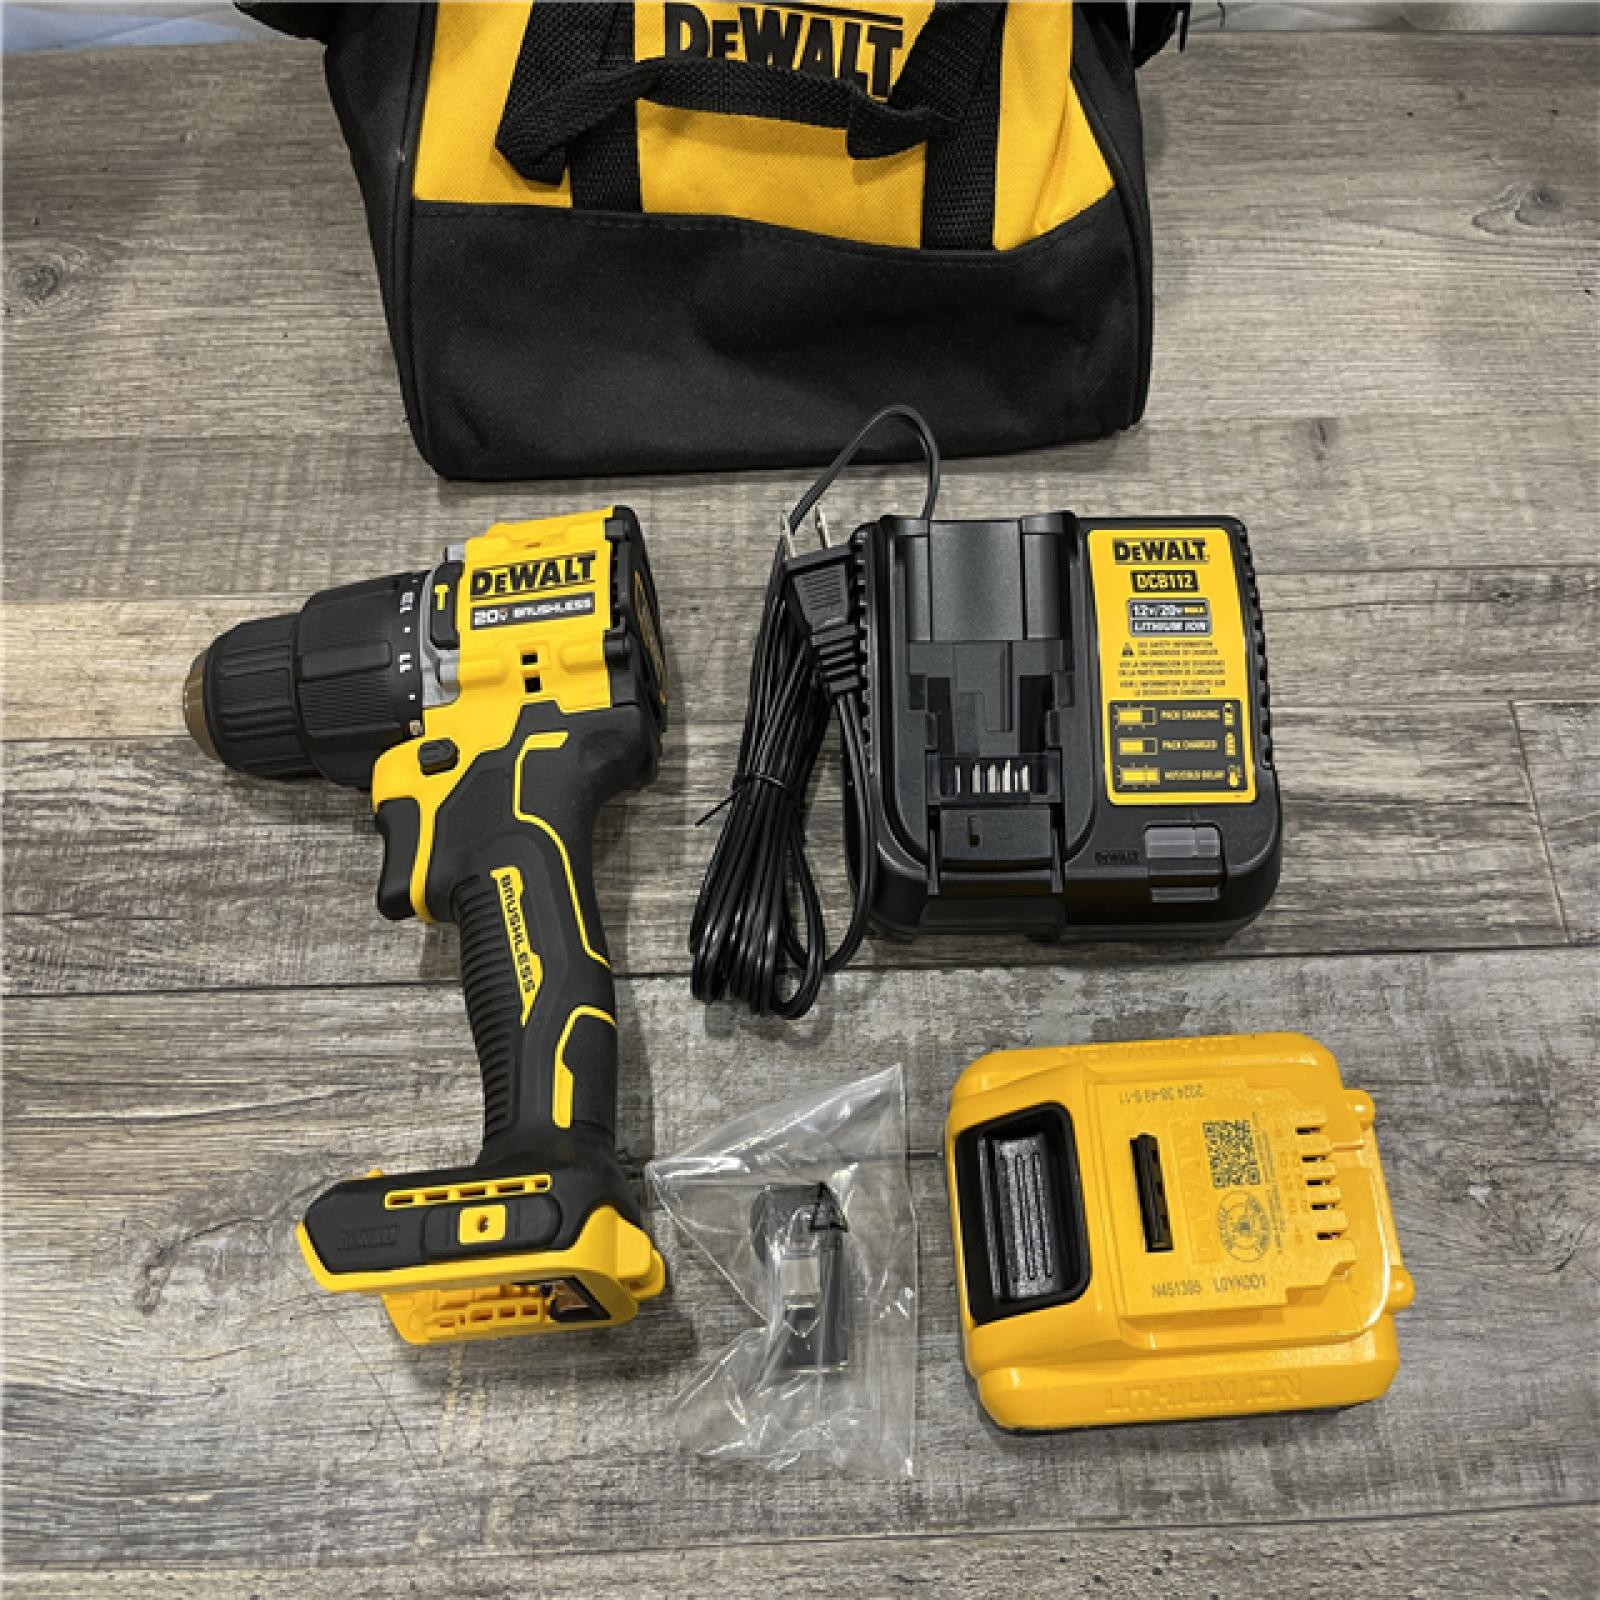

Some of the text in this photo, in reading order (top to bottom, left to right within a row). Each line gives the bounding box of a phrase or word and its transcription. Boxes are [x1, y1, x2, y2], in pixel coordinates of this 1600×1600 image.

[1136, 573, 1194, 589] DCB112
[512, 597, 592, 619] BRUSHLESS
[1134, 621, 1206, 632] LITHIUM ION
[399, 652, 413, 674] 11
[501, 874, 536, 993] BRUSHLESS
[1104, 1374, 1302, 1414] LITHIUM ION
